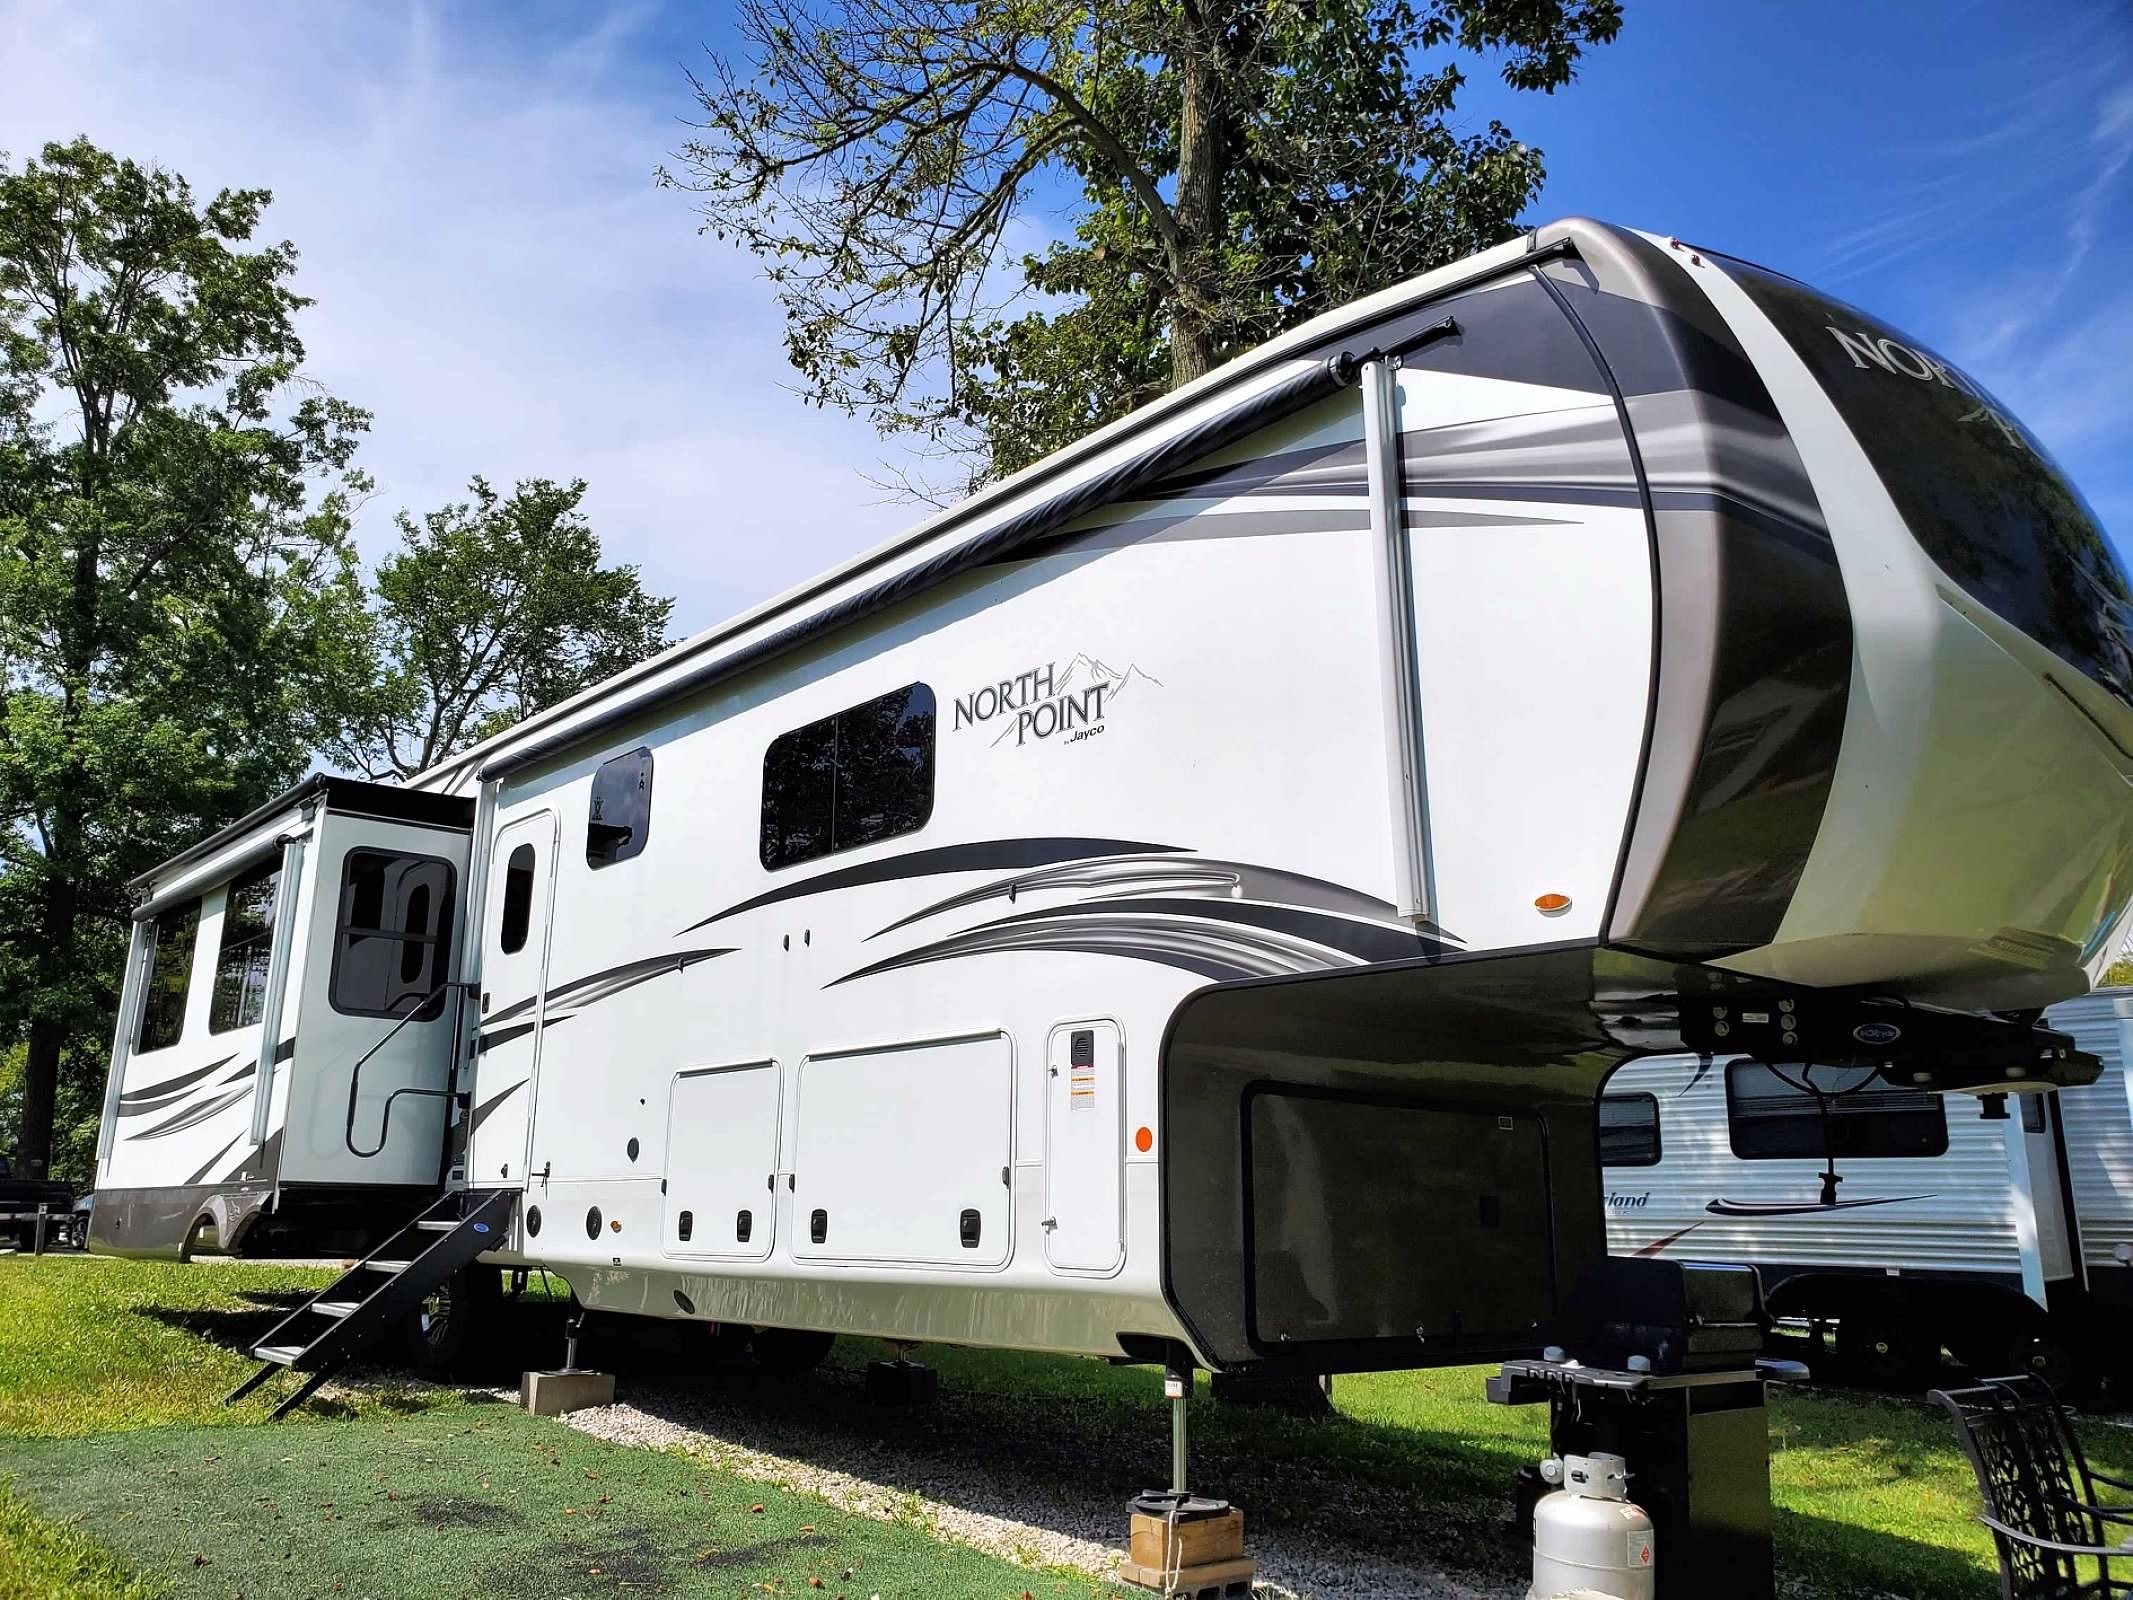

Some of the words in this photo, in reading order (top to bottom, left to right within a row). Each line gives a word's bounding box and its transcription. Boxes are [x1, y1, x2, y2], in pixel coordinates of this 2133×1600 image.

[952, 661, 1056, 732] NORTH
[1016, 680, 1111, 747] POINT
[1070, 724, 1105, 743] Jayco
